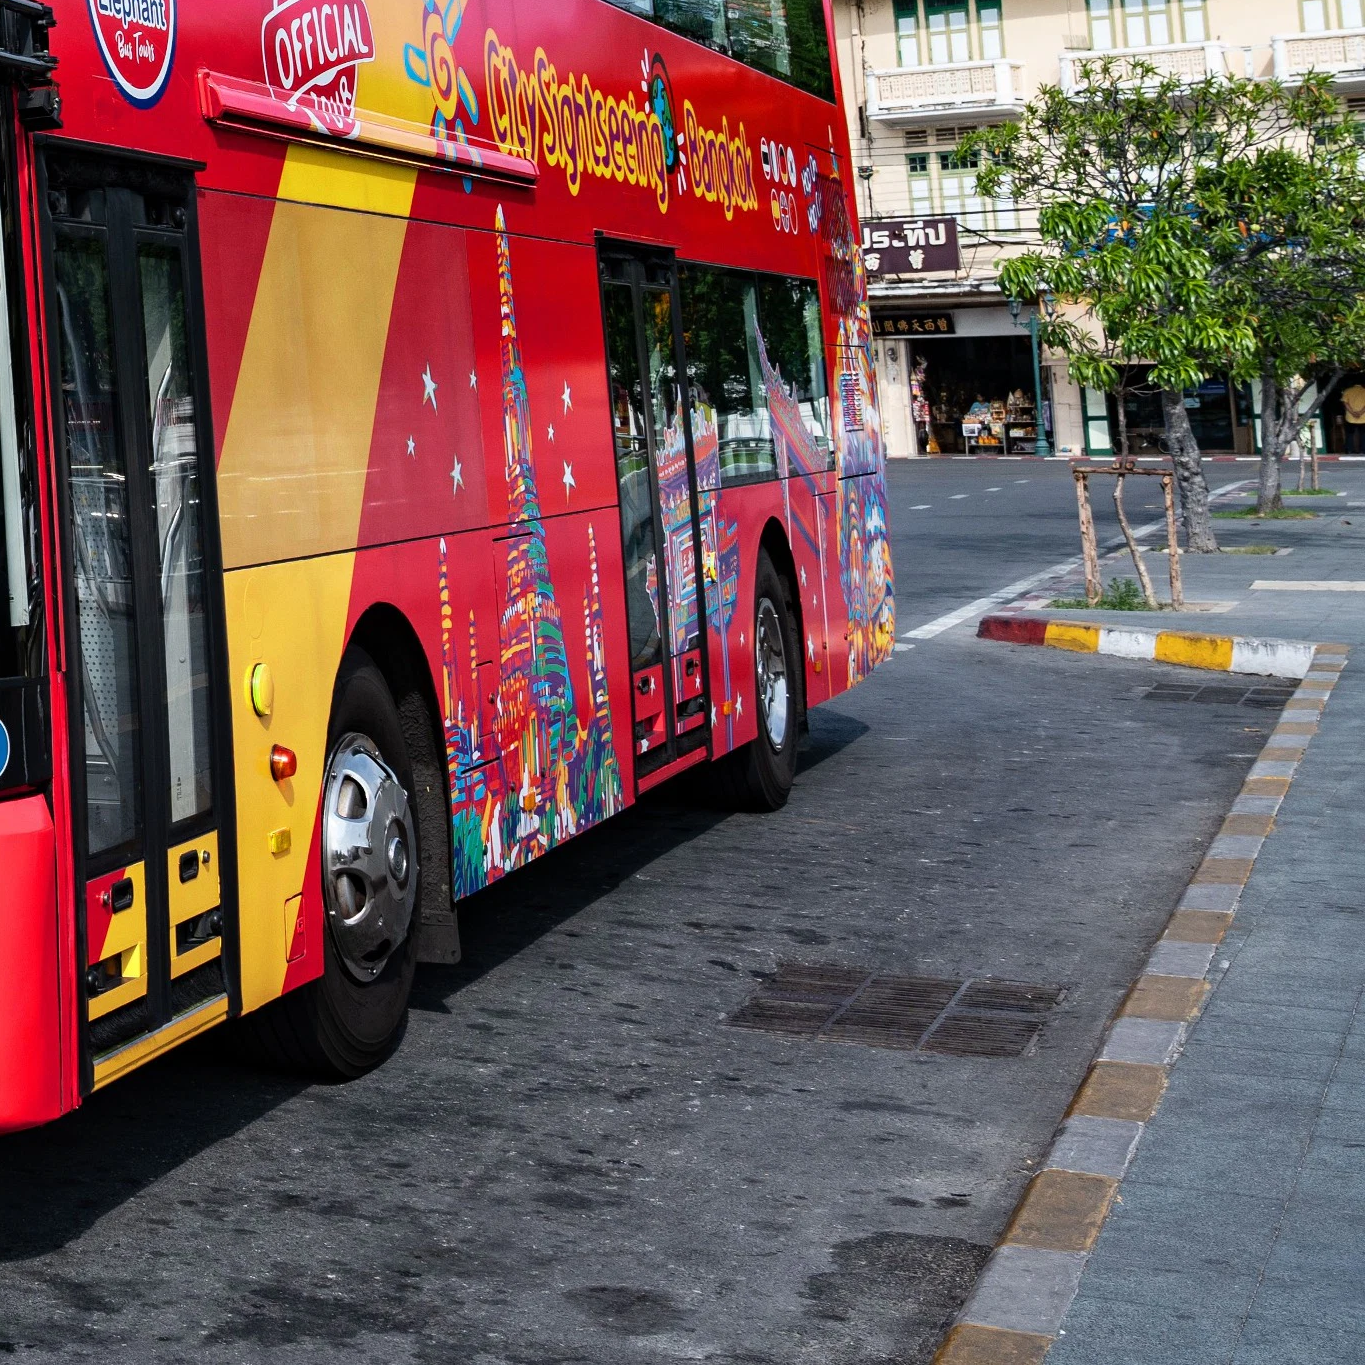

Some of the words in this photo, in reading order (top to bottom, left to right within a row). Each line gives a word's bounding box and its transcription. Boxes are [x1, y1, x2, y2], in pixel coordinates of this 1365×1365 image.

[115, 30, 133, 60] Bus
[133, 31, 155, 64] Tours
[275, 4, 369, 90] OFFICIAL
[684, 99, 758, 221] Bangkok
